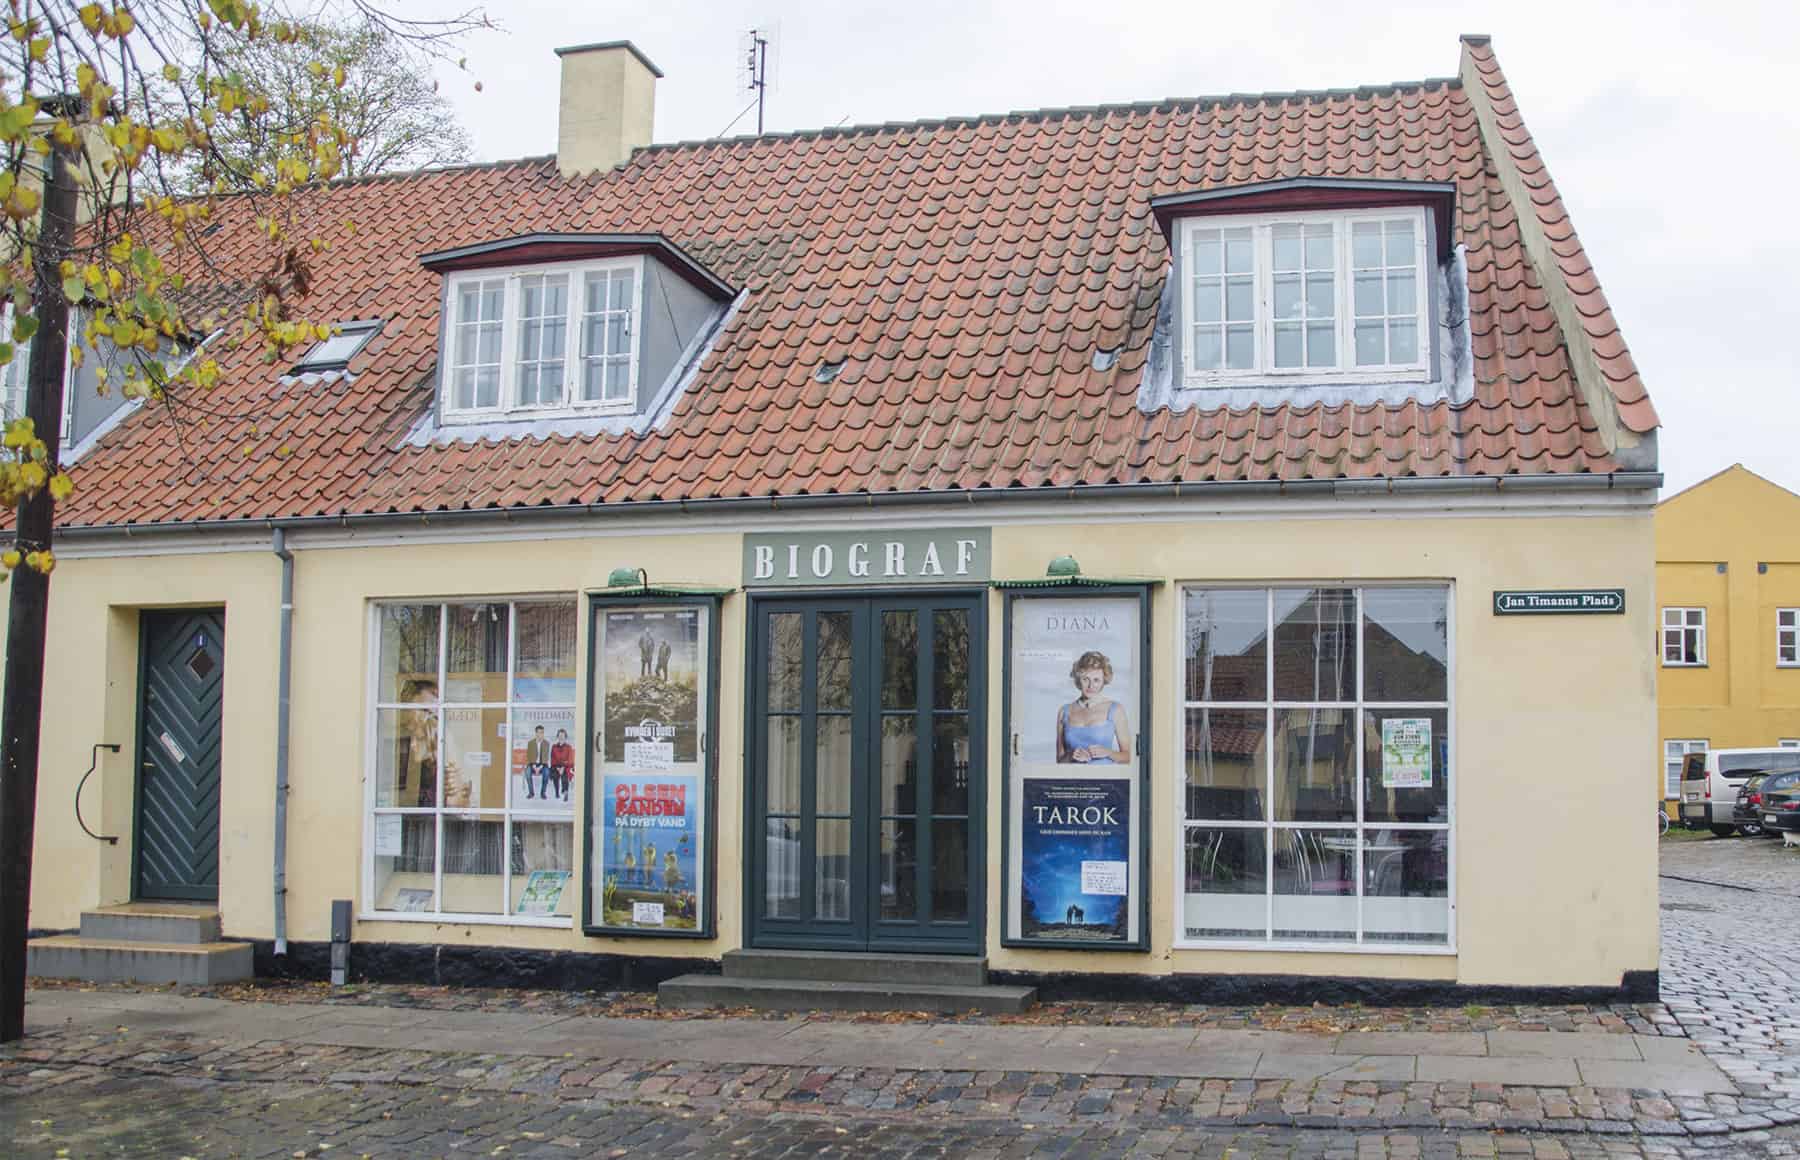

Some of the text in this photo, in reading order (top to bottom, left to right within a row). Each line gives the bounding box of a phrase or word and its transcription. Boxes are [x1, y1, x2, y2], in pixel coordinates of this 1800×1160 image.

[754, 540, 977, 579] BIOGRAF
[1504, 595, 1615, 608] Jan Timanns Plads
[1047, 616, 1110, 630] DIANA
[525, 711, 576, 720] PHILOMEN
[615, 784, 686, 800] OLSEN
[657, 816, 686, 827] VAND
[1032, 805, 1119, 825] TAROK
